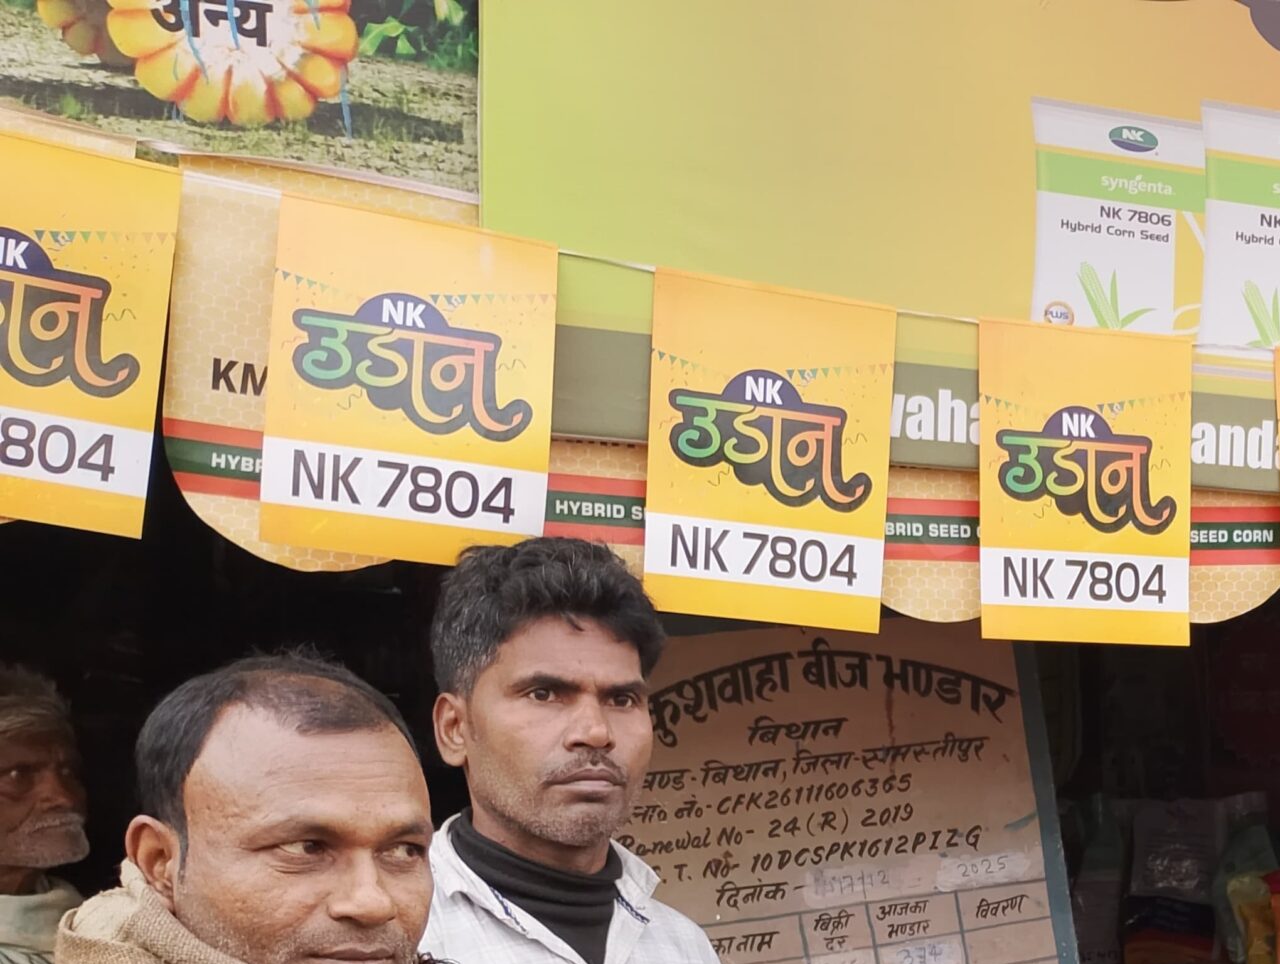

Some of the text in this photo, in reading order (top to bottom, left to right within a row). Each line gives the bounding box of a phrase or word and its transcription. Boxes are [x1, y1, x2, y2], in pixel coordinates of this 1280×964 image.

[1121, 128, 1145, 142] NK
[1101, 174, 1173, 195] syngenta
[1100, 206, 1172, 226] NK 7806
[1061, 219, 1169, 243] Hybrid Corn Seed
[1235, 231, 1274, 246] Hybrid
[382, 299, 425, 328] NK
[745, 376, 783, 405] NK
[1062, 412, 1096, 438] NK
[0, 416, 116, 482] 804
[1191, 420, 1280, 470] and
[292, 449, 515, 523] NK 7804
[555, 499, 625, 520] HYBRID
[885, 522, 973, 539] BRID SEED
[1190, 529, 1274, 543] SEED CORN
[670, 524, 857, 587] NK 7804
[1003, 556, 1166, 604] NK 7804
[797, 637, 873, 690] बीज
[876, 653, 1017, 723] भण्डार
[748, 716, 848, 746] बिथान
[768, 817, 801, 839] 24
[861, 803, 914, 827] 2019
[957, 855, 1008, 877] 2025
[976, 894, 1030, 919] विवरण
[824, 935, 848, 950] दर
